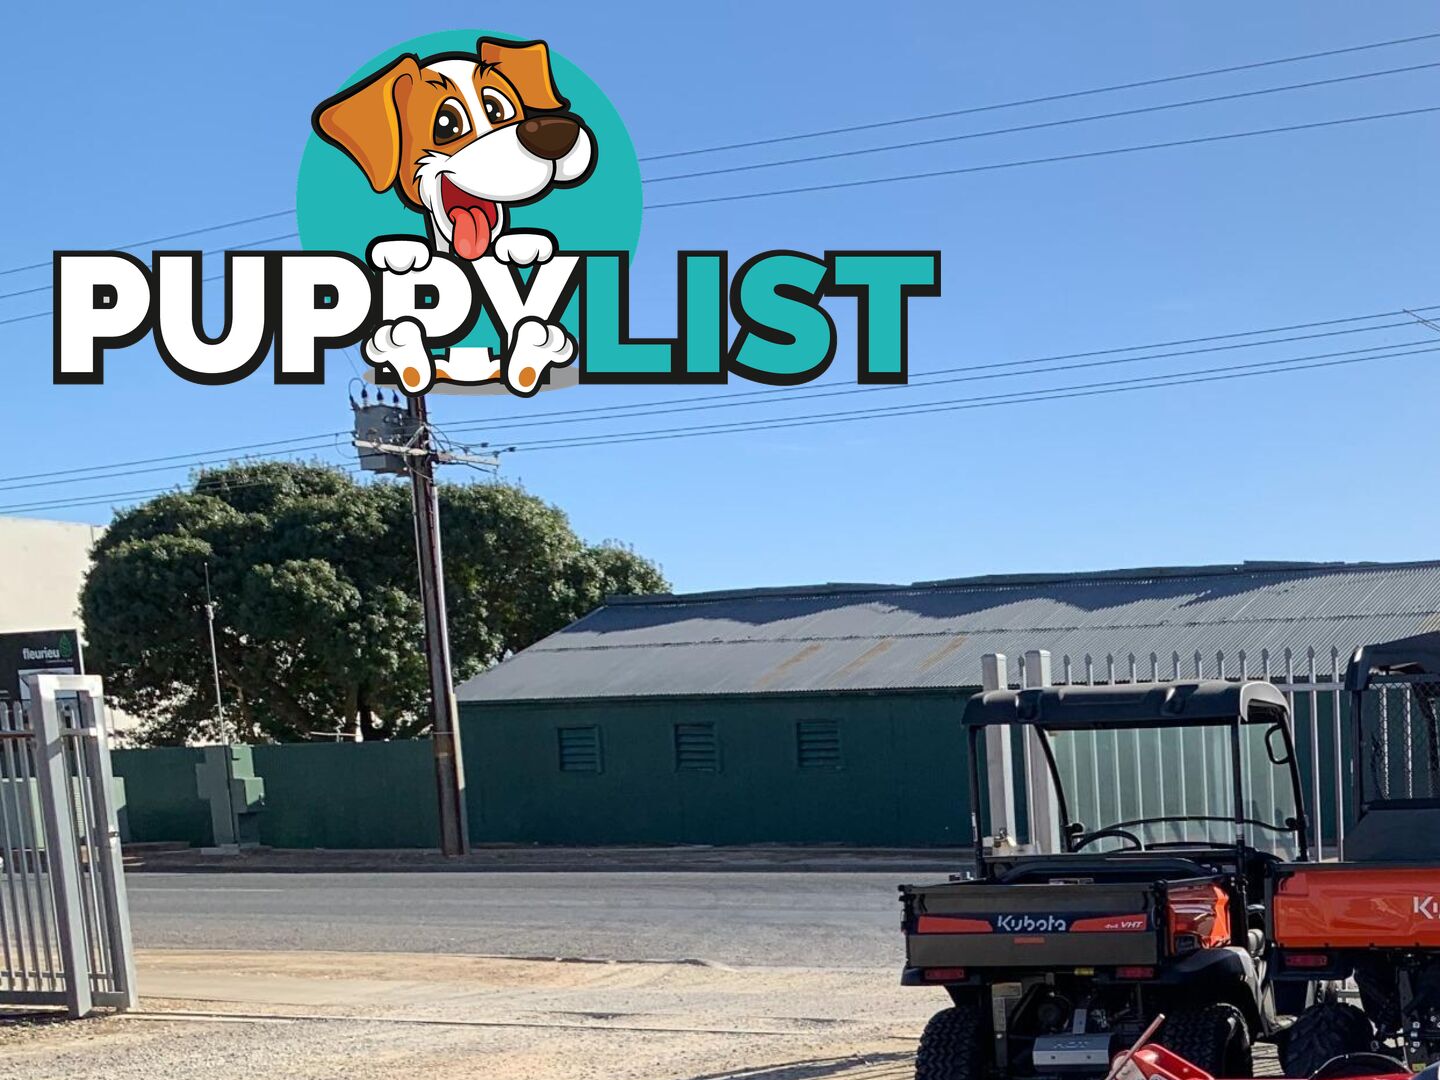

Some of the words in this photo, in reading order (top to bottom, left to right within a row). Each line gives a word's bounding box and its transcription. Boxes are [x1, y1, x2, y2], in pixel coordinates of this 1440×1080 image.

[22, 646, 60, 660] fleurieu
[997, 914, 1066, 932] Kubota
[1121, 921, 1143, 929] VHT
